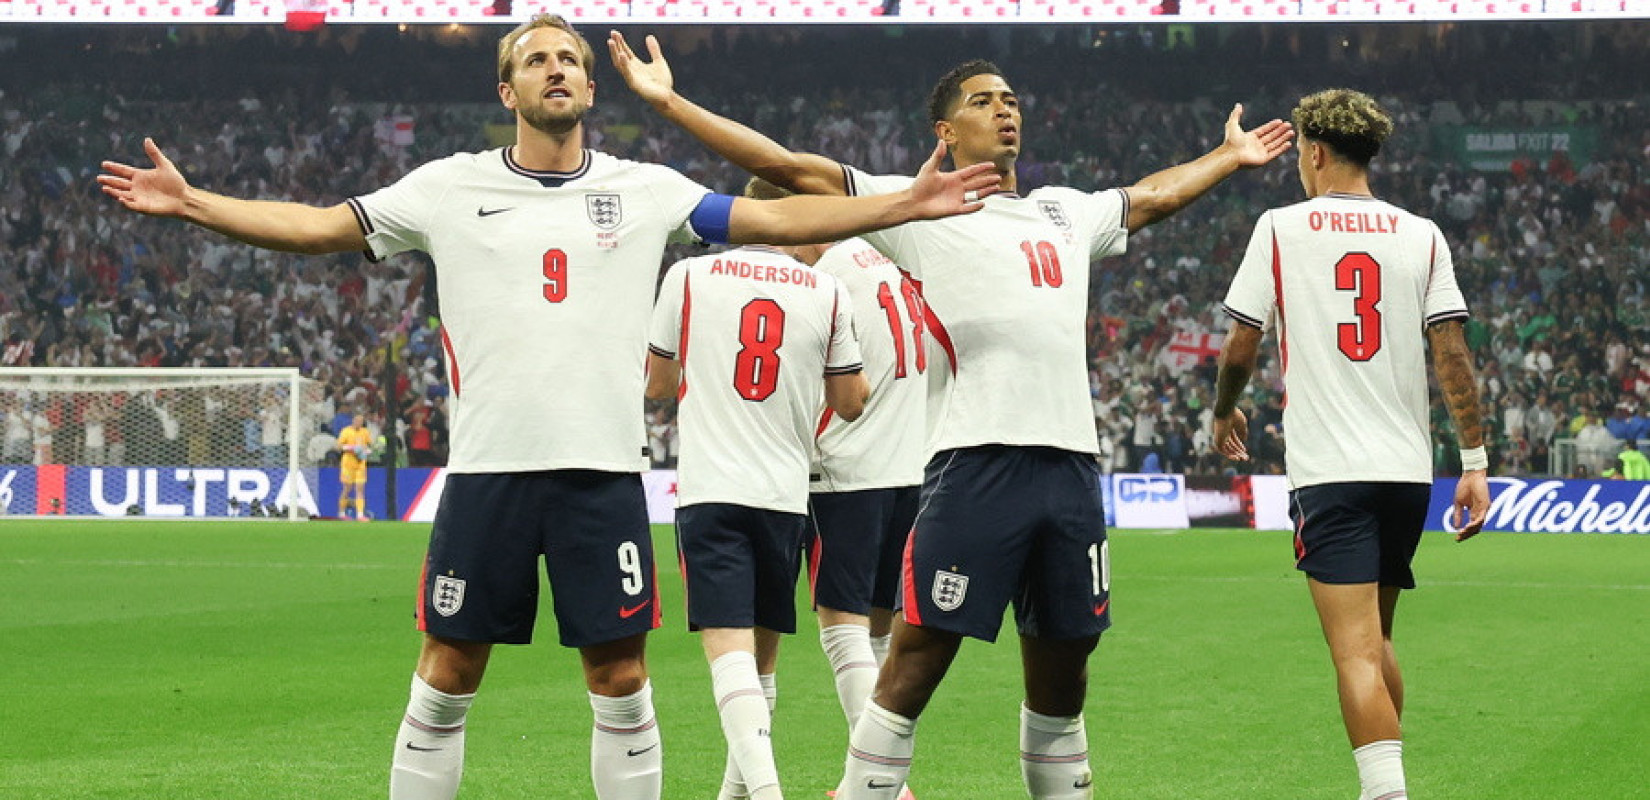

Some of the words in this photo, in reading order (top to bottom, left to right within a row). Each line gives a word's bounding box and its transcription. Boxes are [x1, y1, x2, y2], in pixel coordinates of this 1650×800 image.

[1309, 211, 1398, 234] O'REILLY
[543, 248, 568, 303] 9
[710, 258, 817, 289] ANDERSON
[1020, 240, 1062, 288] 10
[1334, 251, 1382, 362] 3
[733, 298, 786, 402] 8
[88, 468, 321, 518] ULTRA
[617, 541, 643, 596] 9
[1088, 539, 1110, 595] 10
